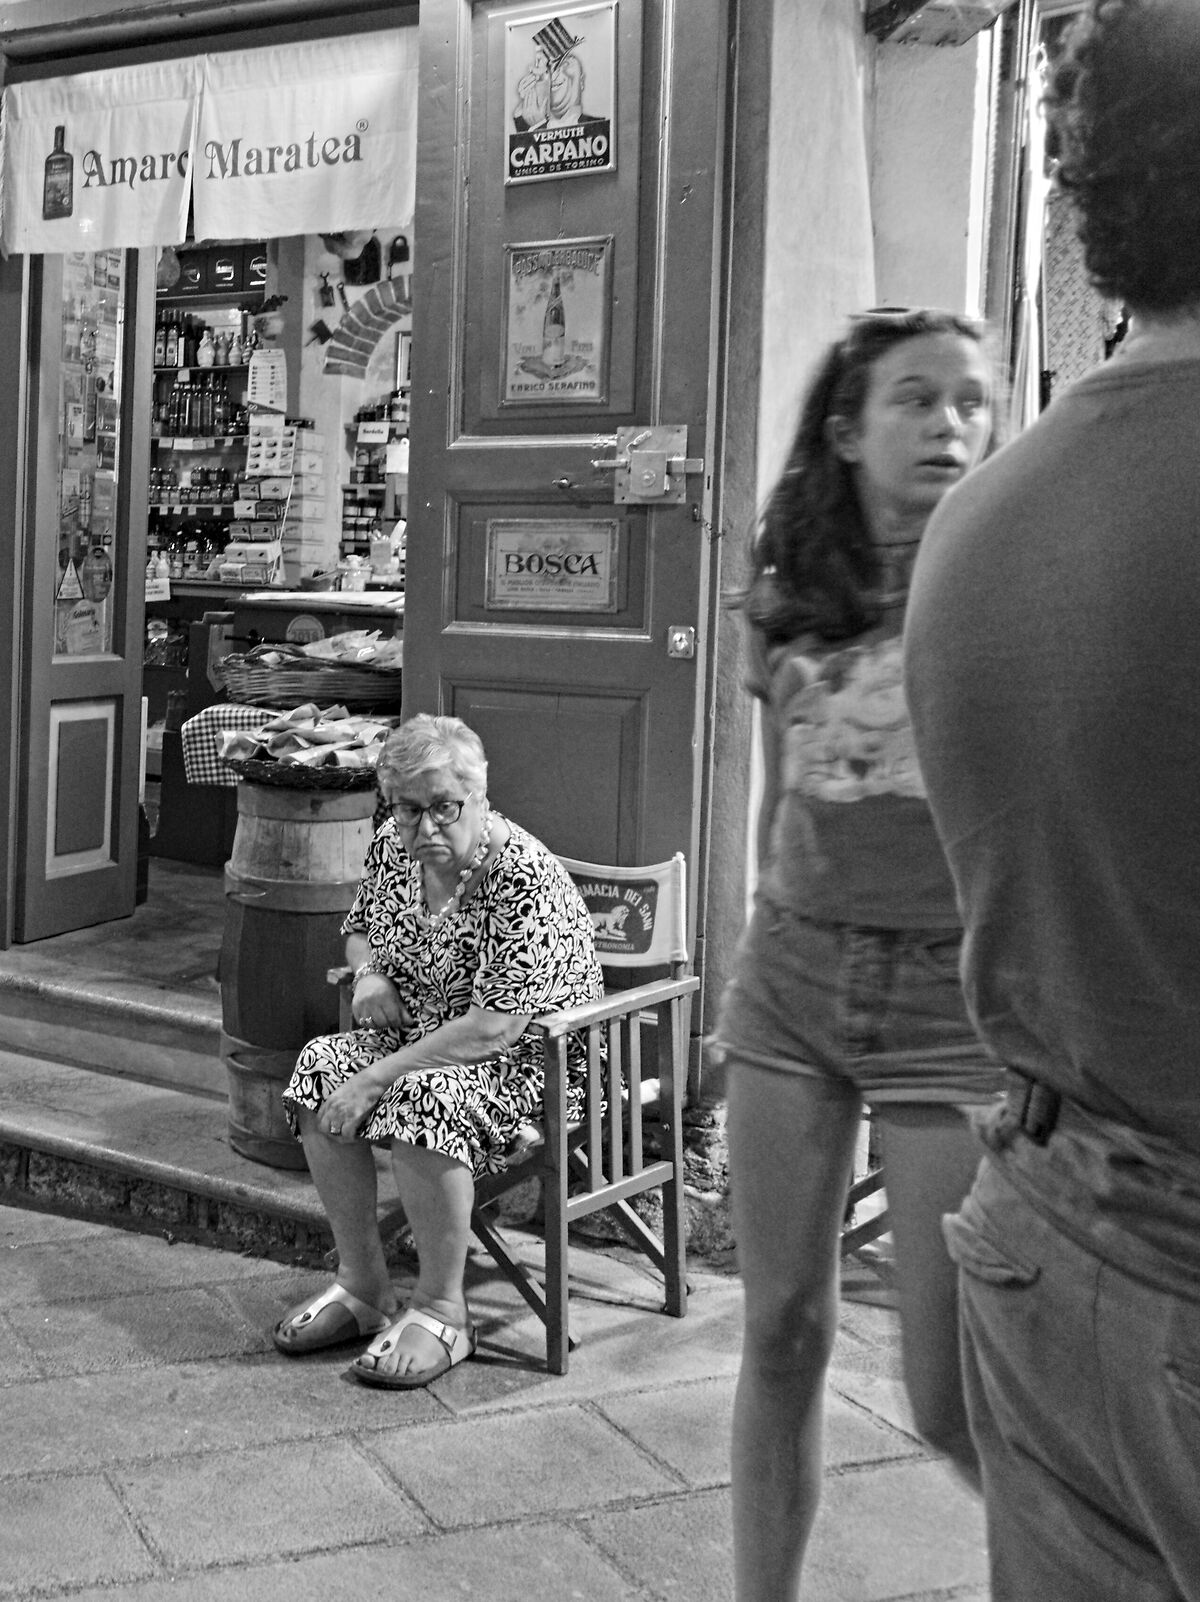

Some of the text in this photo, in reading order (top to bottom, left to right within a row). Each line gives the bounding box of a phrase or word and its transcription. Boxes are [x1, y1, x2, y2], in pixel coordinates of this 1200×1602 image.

[533, 126, 585, 143] VERMUTH
[510, 135, 608, 168] CARPANO
[565, 158, 605, 169] TORINO
[511, 381, 596, 392] ENRICO SERAFINO
[505, 552, 600, 575] BOSCA
